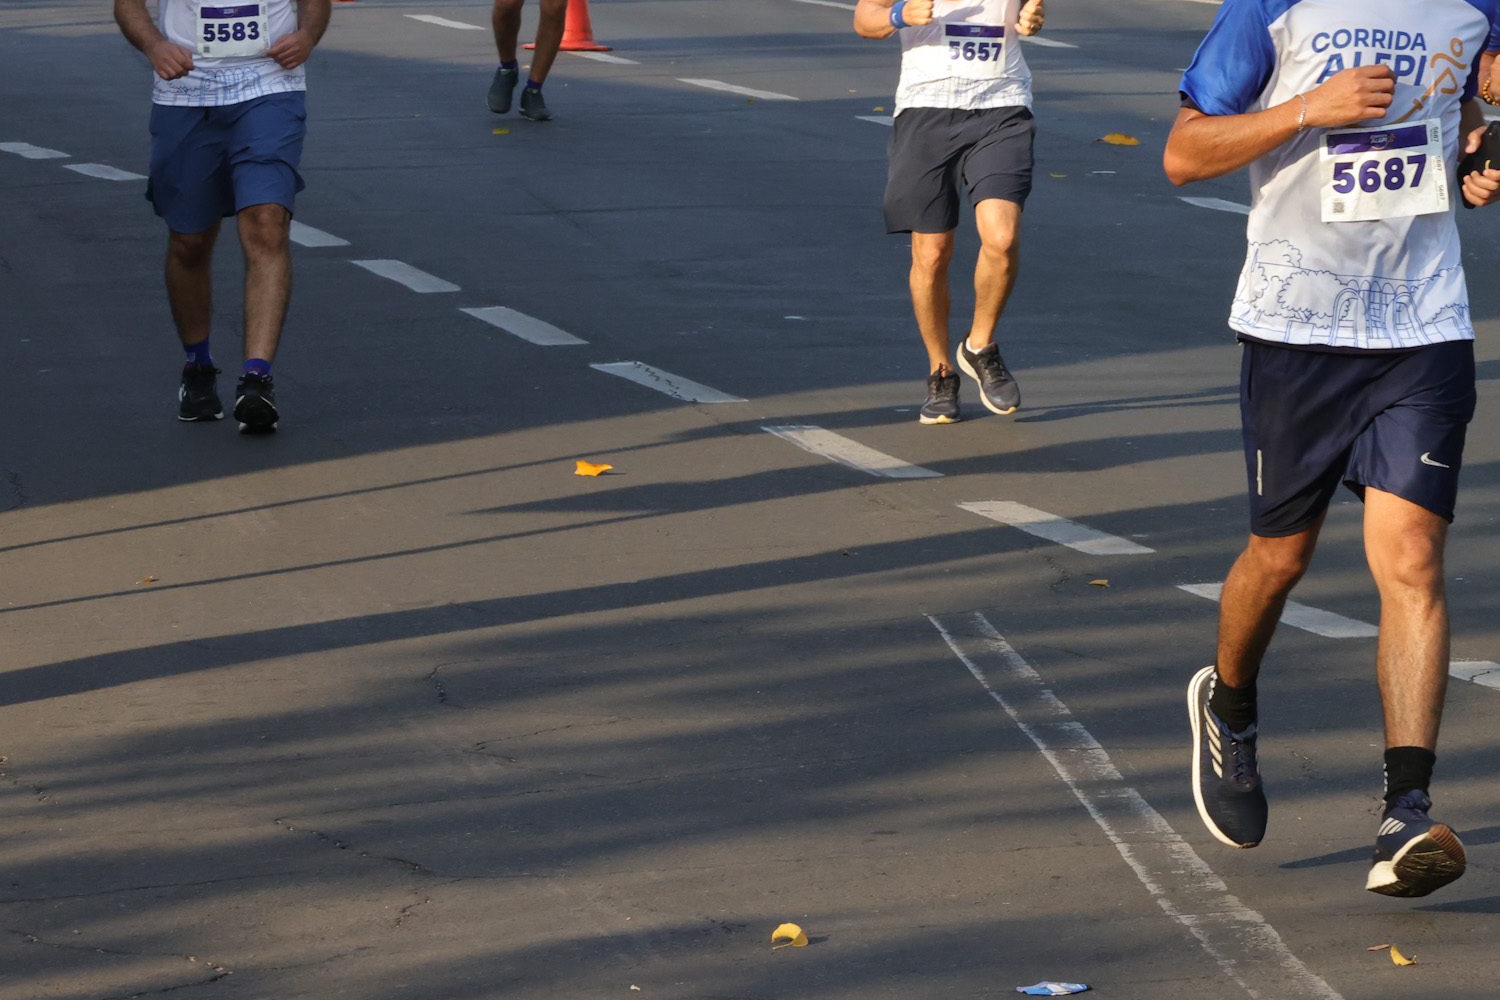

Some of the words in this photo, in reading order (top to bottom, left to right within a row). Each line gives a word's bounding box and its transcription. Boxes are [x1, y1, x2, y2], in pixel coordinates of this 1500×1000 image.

[203, 21, 260, 42] 5583
[1312, 28, 1427, 53] CORRIDA
[949, 41, 1002, 62] 5657
[1333, 153, 1427, 194] 5687
